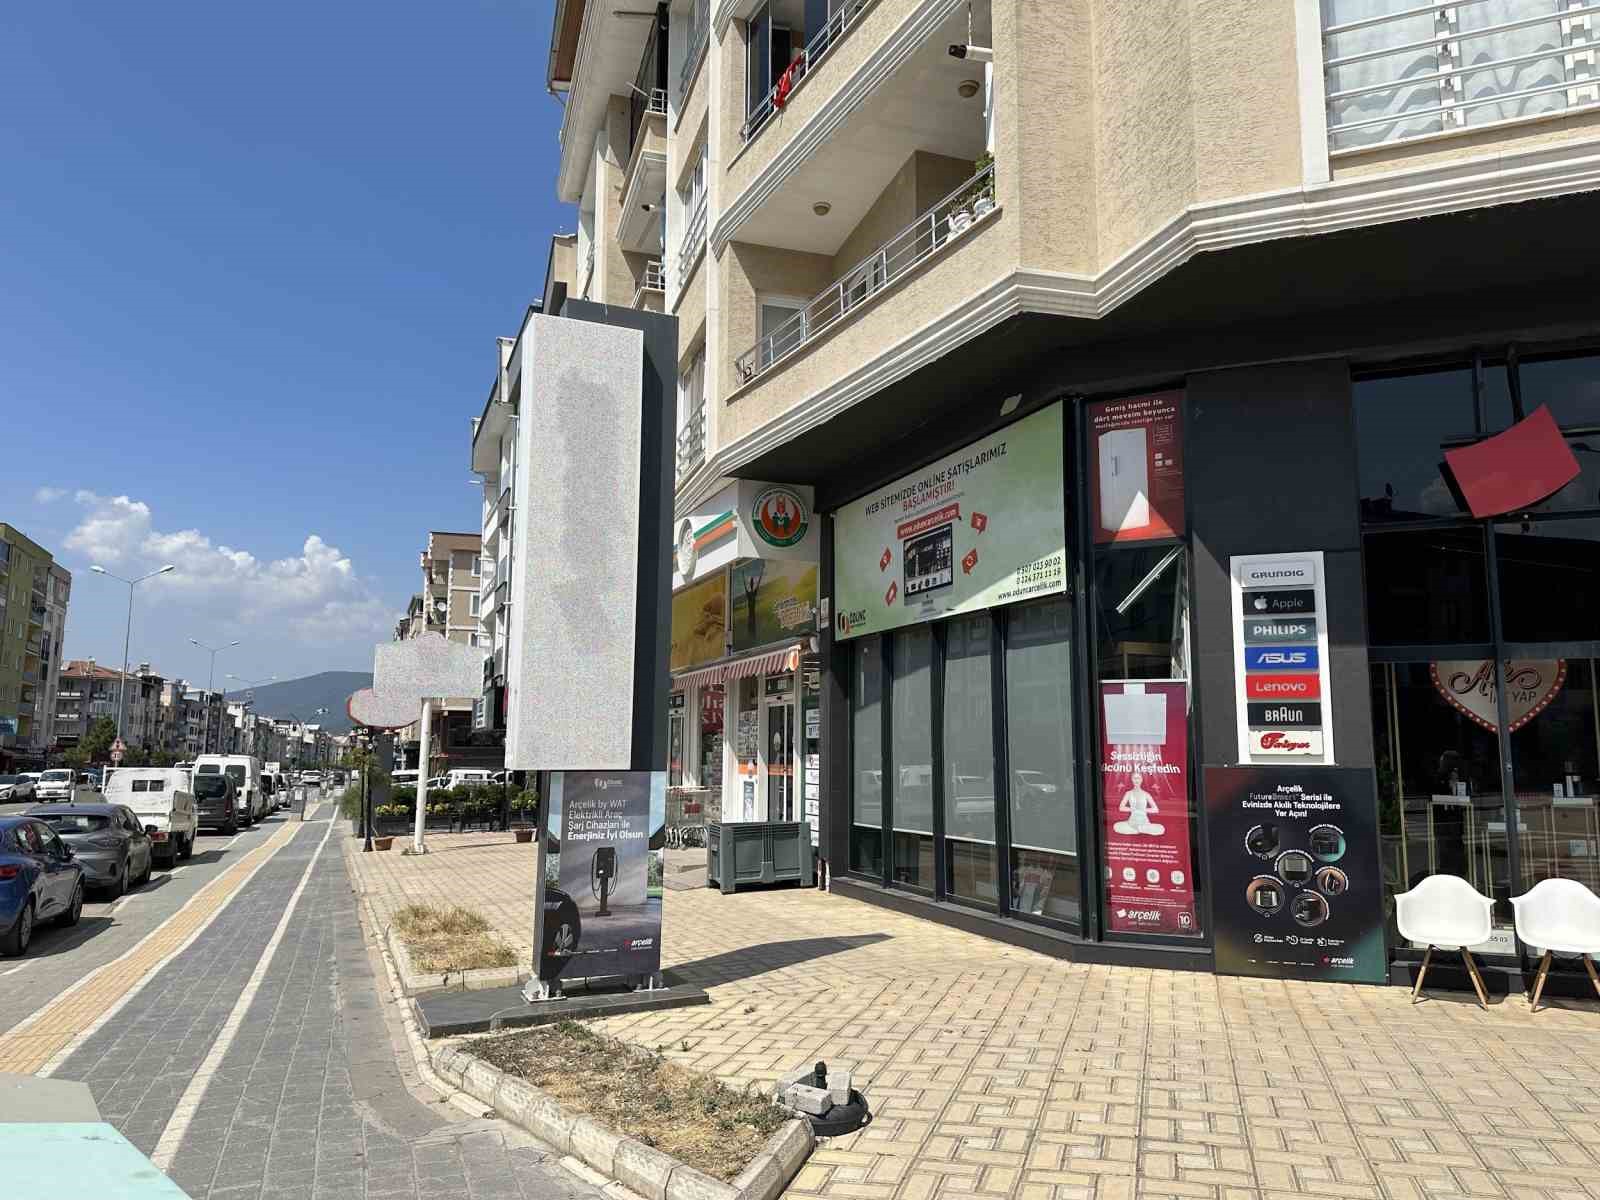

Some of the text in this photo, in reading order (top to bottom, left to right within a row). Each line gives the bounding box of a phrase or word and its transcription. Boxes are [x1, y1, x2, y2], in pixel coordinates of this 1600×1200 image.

[1112, 411, 1141, 421] mevsim
[1143, 405, 1176, 417] boyunca
[864, 502, 881, 520] WEB
[1251, 569, 1305, 580] GRUNDIG
[1271, 598, 1305, 611] Apple
[1253, 624, 1308, 636] PHILIPS
[1256, 652, 1307, 664] ASUS
[1255, 680, 1307, 692] Lenovo
[1511, 690, 1537, 703] YAP
[1264, 706, 1304, 722] BRAUN
[1134, 763, 1181, 776] Keşfedin
[1277, 785, 1303, 794] Arçelik
[1300, 793, 1322, 801] Serisi
[1323, 793, 1333, 801] ile
[569, 800, 626, 810] Arçelik by WAT
[1242, 800, 1273, 809] Evinizde
[1293, 801, 1341, 811] Teknolojilere
[1275, 809, 1287, 817] Yer
[567, 831, 605, 842] Enerjiniz
[619, 830, 644, 841] Olsun
